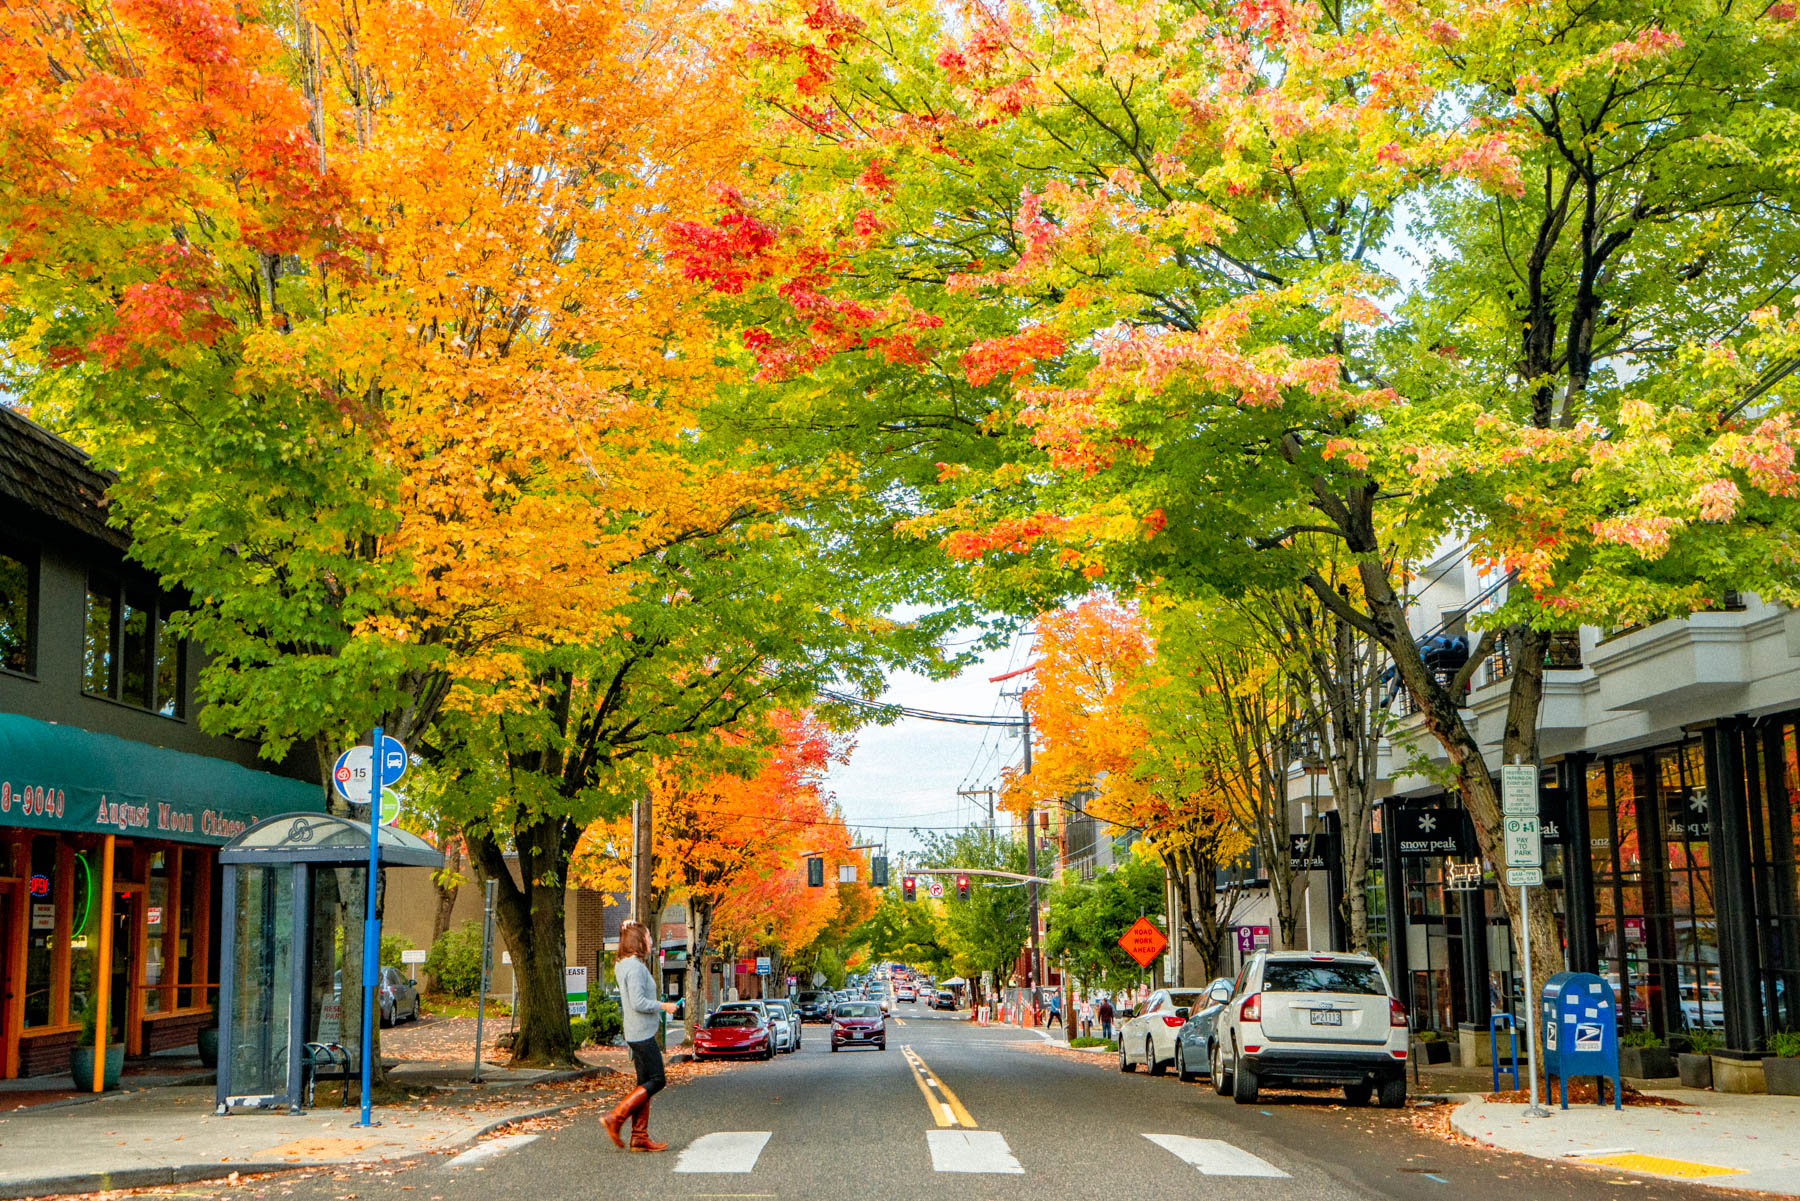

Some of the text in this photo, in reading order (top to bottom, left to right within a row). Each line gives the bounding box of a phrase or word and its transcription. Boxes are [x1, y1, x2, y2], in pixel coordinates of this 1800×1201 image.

[353, 768, 366, 777] 15
[96, 794, 246, 838] August Moon Chinese
[1400, 836, 1456, 852] snow peak
[1303, 855, 1324, 867] pak
[31, 877, 48, 893] OPEN
[1242, 937, 1250, 948] 4
